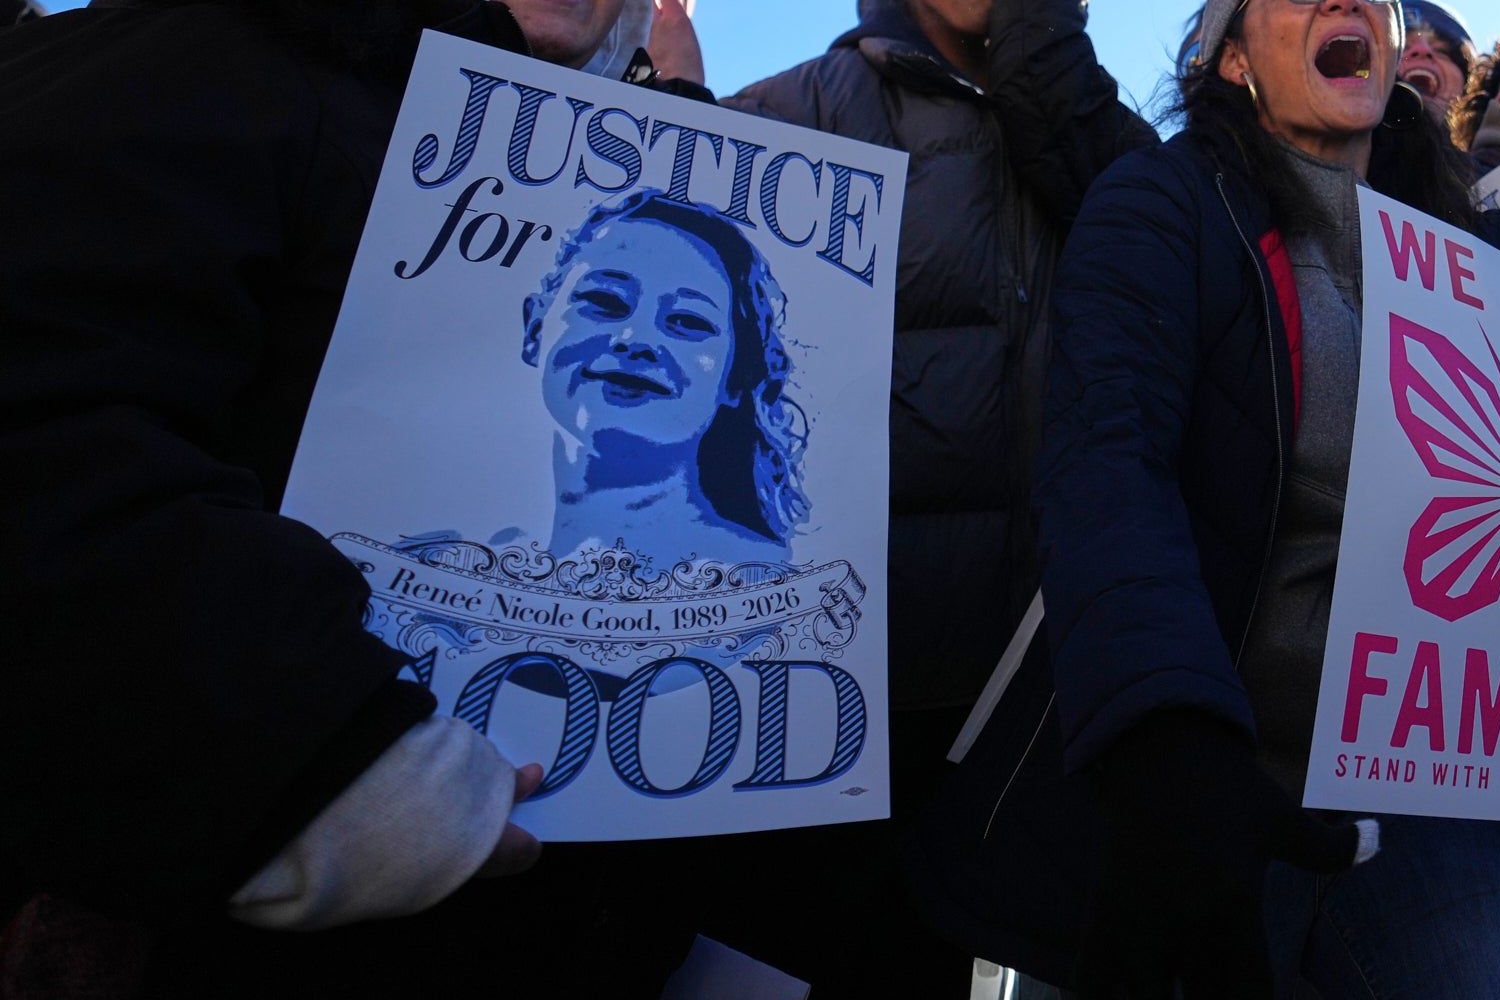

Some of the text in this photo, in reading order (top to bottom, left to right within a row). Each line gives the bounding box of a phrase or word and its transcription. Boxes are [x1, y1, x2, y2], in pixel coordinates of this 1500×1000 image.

[393, 175, 553, 280] for
[411, 66, 885, 288] JUSTICE
[1377, 208, 1485, 311] WE
[385, 566, 484, 613] Reneé
[487, 590, 575, 629] Nicole
[581, 605, 661, 637] Good,
[398, 647, 869, 802] OOD
[1335, 752, 1417, 784] STAND
[1431, 761, 1490, 791] WITH
